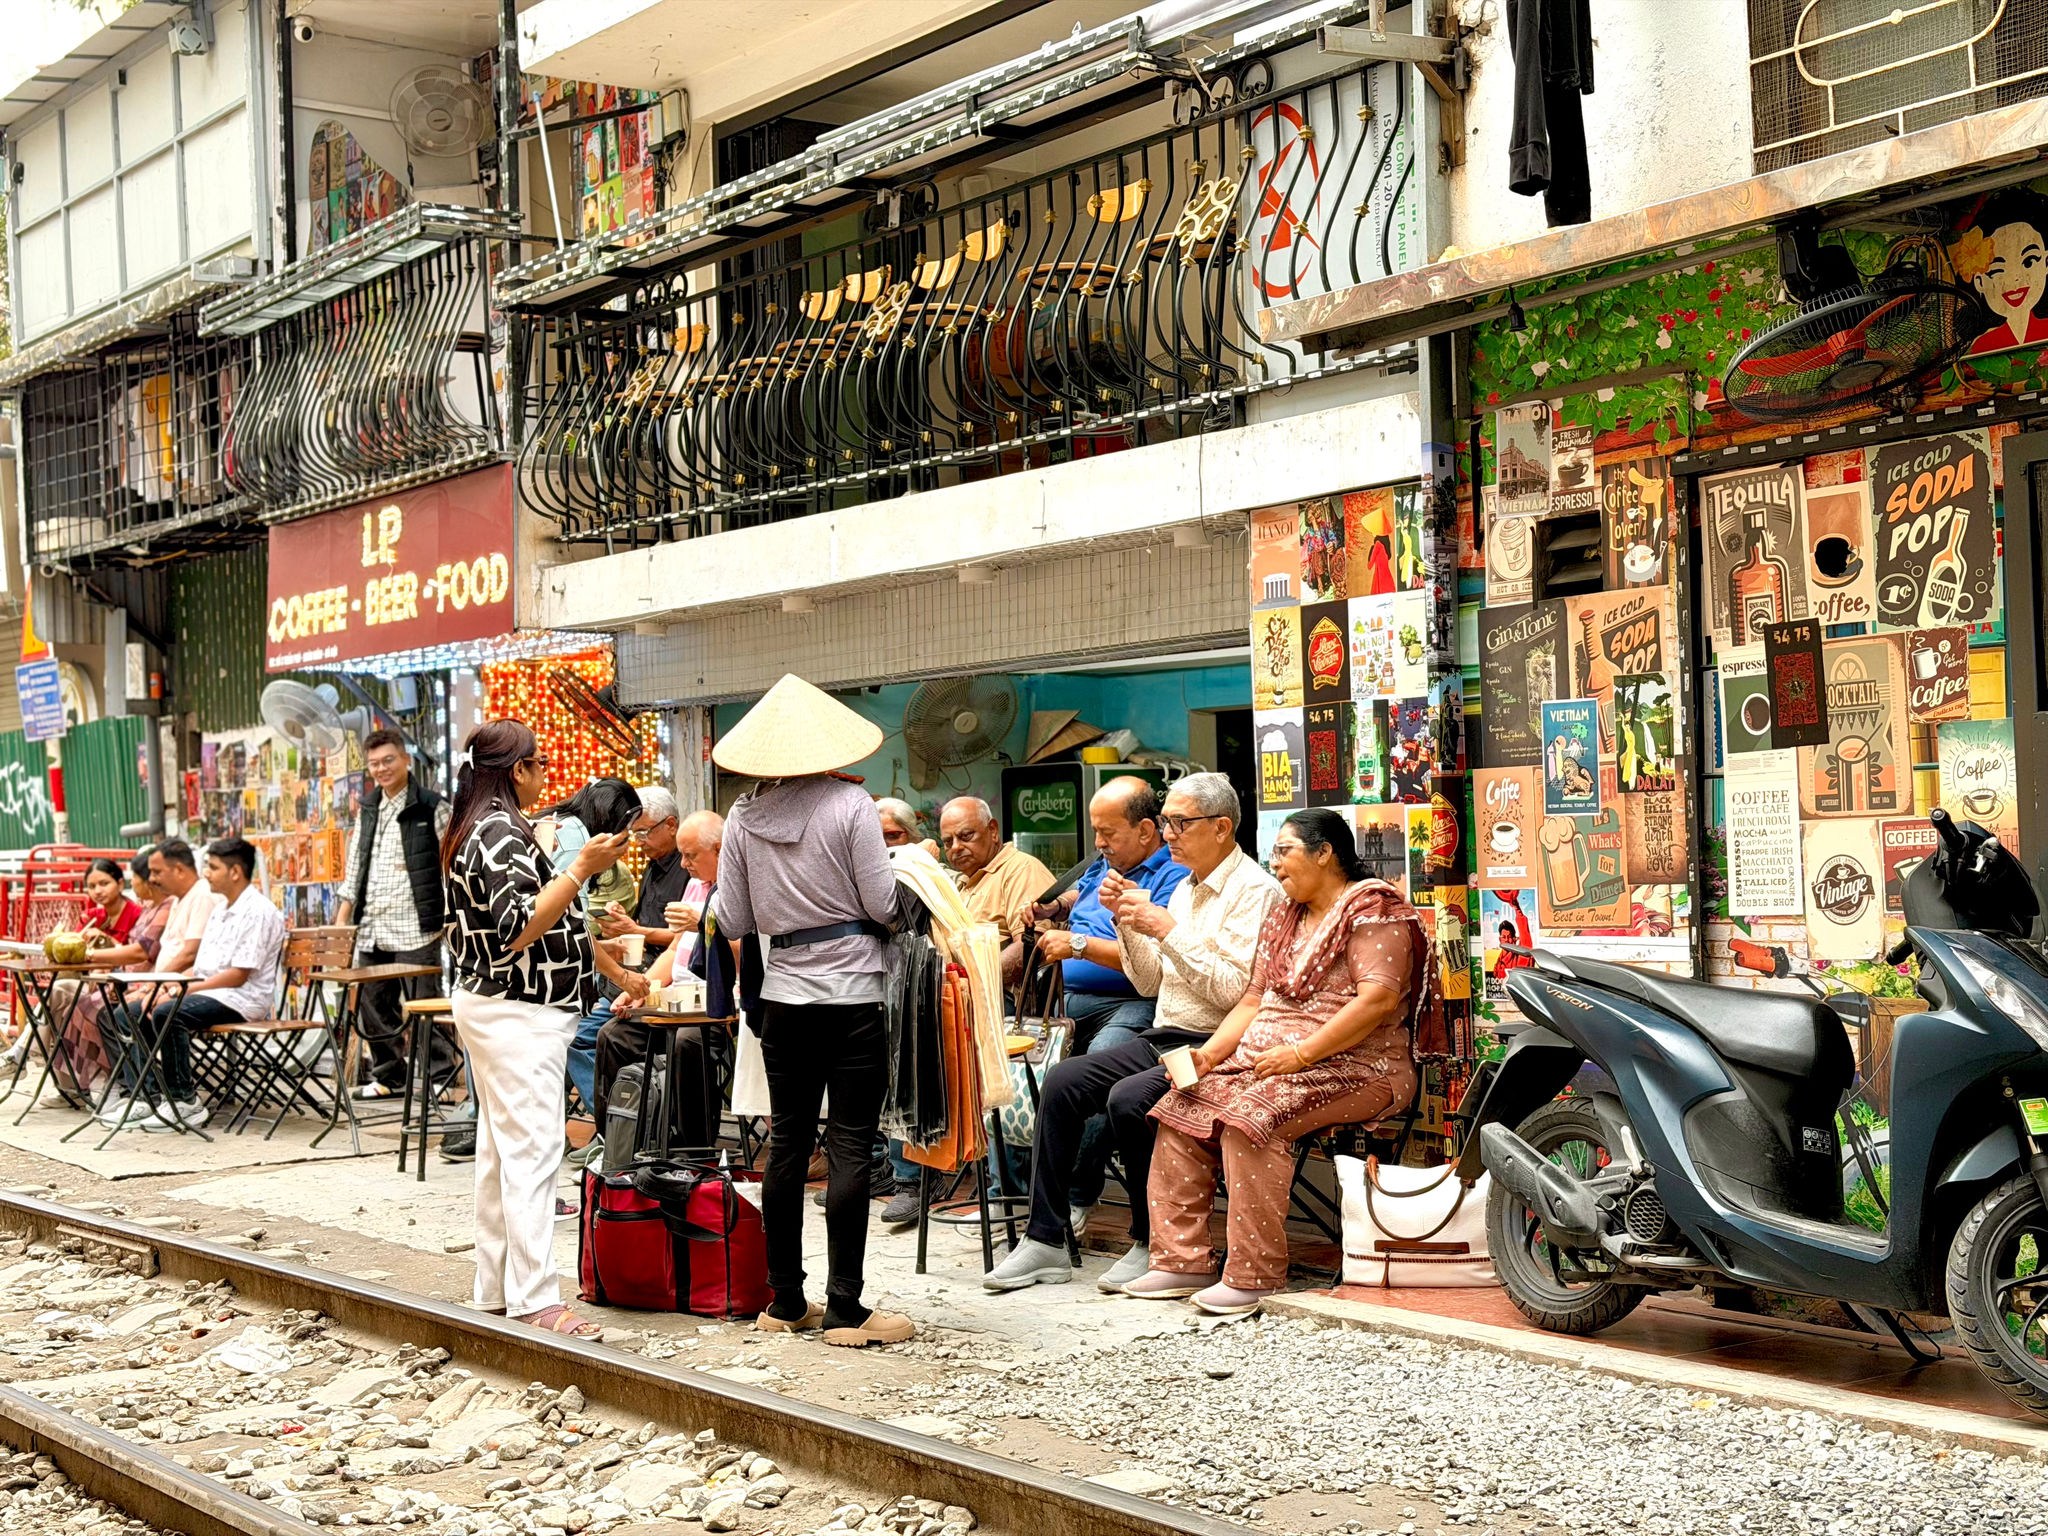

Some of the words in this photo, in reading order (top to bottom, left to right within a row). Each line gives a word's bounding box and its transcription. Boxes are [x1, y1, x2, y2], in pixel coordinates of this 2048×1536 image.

[1397, 223, 1407, 270] PANEL
[1550, 430, 1592, 454] Gourmet
[1560, 430, 1580, 440] FRESH
[1613, 468, 1626, 481] the
[1886, 461, 1910, 484] ICE
[1913, 444, 1952, 473] COLD
[1603, 483, 1638, 515] Coffee
[1708, 473, 1796, 521] TEQUILA
[1886, 453, 1974, 523] SODA
[1501, 498, 1548, 513] VIETNAM
[1551, 491, 1593, 512] ESPRESSO
[361, 504, 403, 568] LP
[1257, 521, 1293, 540] HANOI
[1609, 518, 1640, 551] Lover
[1889, 505, 1953, 562] POP
[267, 585, 349, 643] COFFEE
[365, 571, 419, 626] BEER
[435, 552, 509, 614] FOOD
[1883, 583, 1913, 605] 1¢
[1928, 582, 1956, 604] SODA
[1602, 608, 1618, 627] ICE
[1619, 595, 1646, 618] COLD
[1610, 615, 1656, 659] SODA
[1773, 629, 1791, 645] 54
[1793, 626, 1811, 642] 75
[1623, 643, 1658, 674] POP
[1826, 682, 1879, 708] OCKTAIL
[1550, 708, 1590, 722] VIETNAM
[1261, 751, 1292, 777] BIA
[1957, 757, 2002, 780] Coffee
[1485, 777, 1520, 805] Coffee
[1643, 796, 1672, 804] BLACK
[1732, 790, 1790, 805] COFFEE
[1017, 788, 1074, 820] Carlsberg
[1644, 805, 1672, 814] HELL
[1732, 807, 1761, 815] LATTE
[1762, 804, 1790, 814] CAFE
[1644, 815, 1673, 827] STRONG
[1588, 834, 1622, 849] What's
[1734, 828, 1768, 839] MOCHA
[1886, 830, 1936, 845] COFFEE
[1742, 848, 1769, 856] FRAPPE
[1771, 847, 1794, 856] IRISH
[1742, 856, 1794, 867] MACCHIATO
[1599, 855, 1614, 873] for
[1734, 840, 1743, 898] ESPRESSO
[1742, 867, 1785, 876] CORTADO
[1591, 879, 1624, 904] Dinner
[1743, 879, 1769, 887] TALL
[1770, 878, 1788, 886] ICED
[1787, 866, 1796, 896] GRANDE
[1815, 876, 1869, 908] Vintage
[1736, 899, 1769, 907] DOUBLE
[1773, 898, 1795, 907] SHOT
[1552, 909, 1574, 923] Best
[1575, 913, 1585, 922] in
[1587, 907, 1617, 922] Town!
[1546, 985, 1595, 1011] VISION
